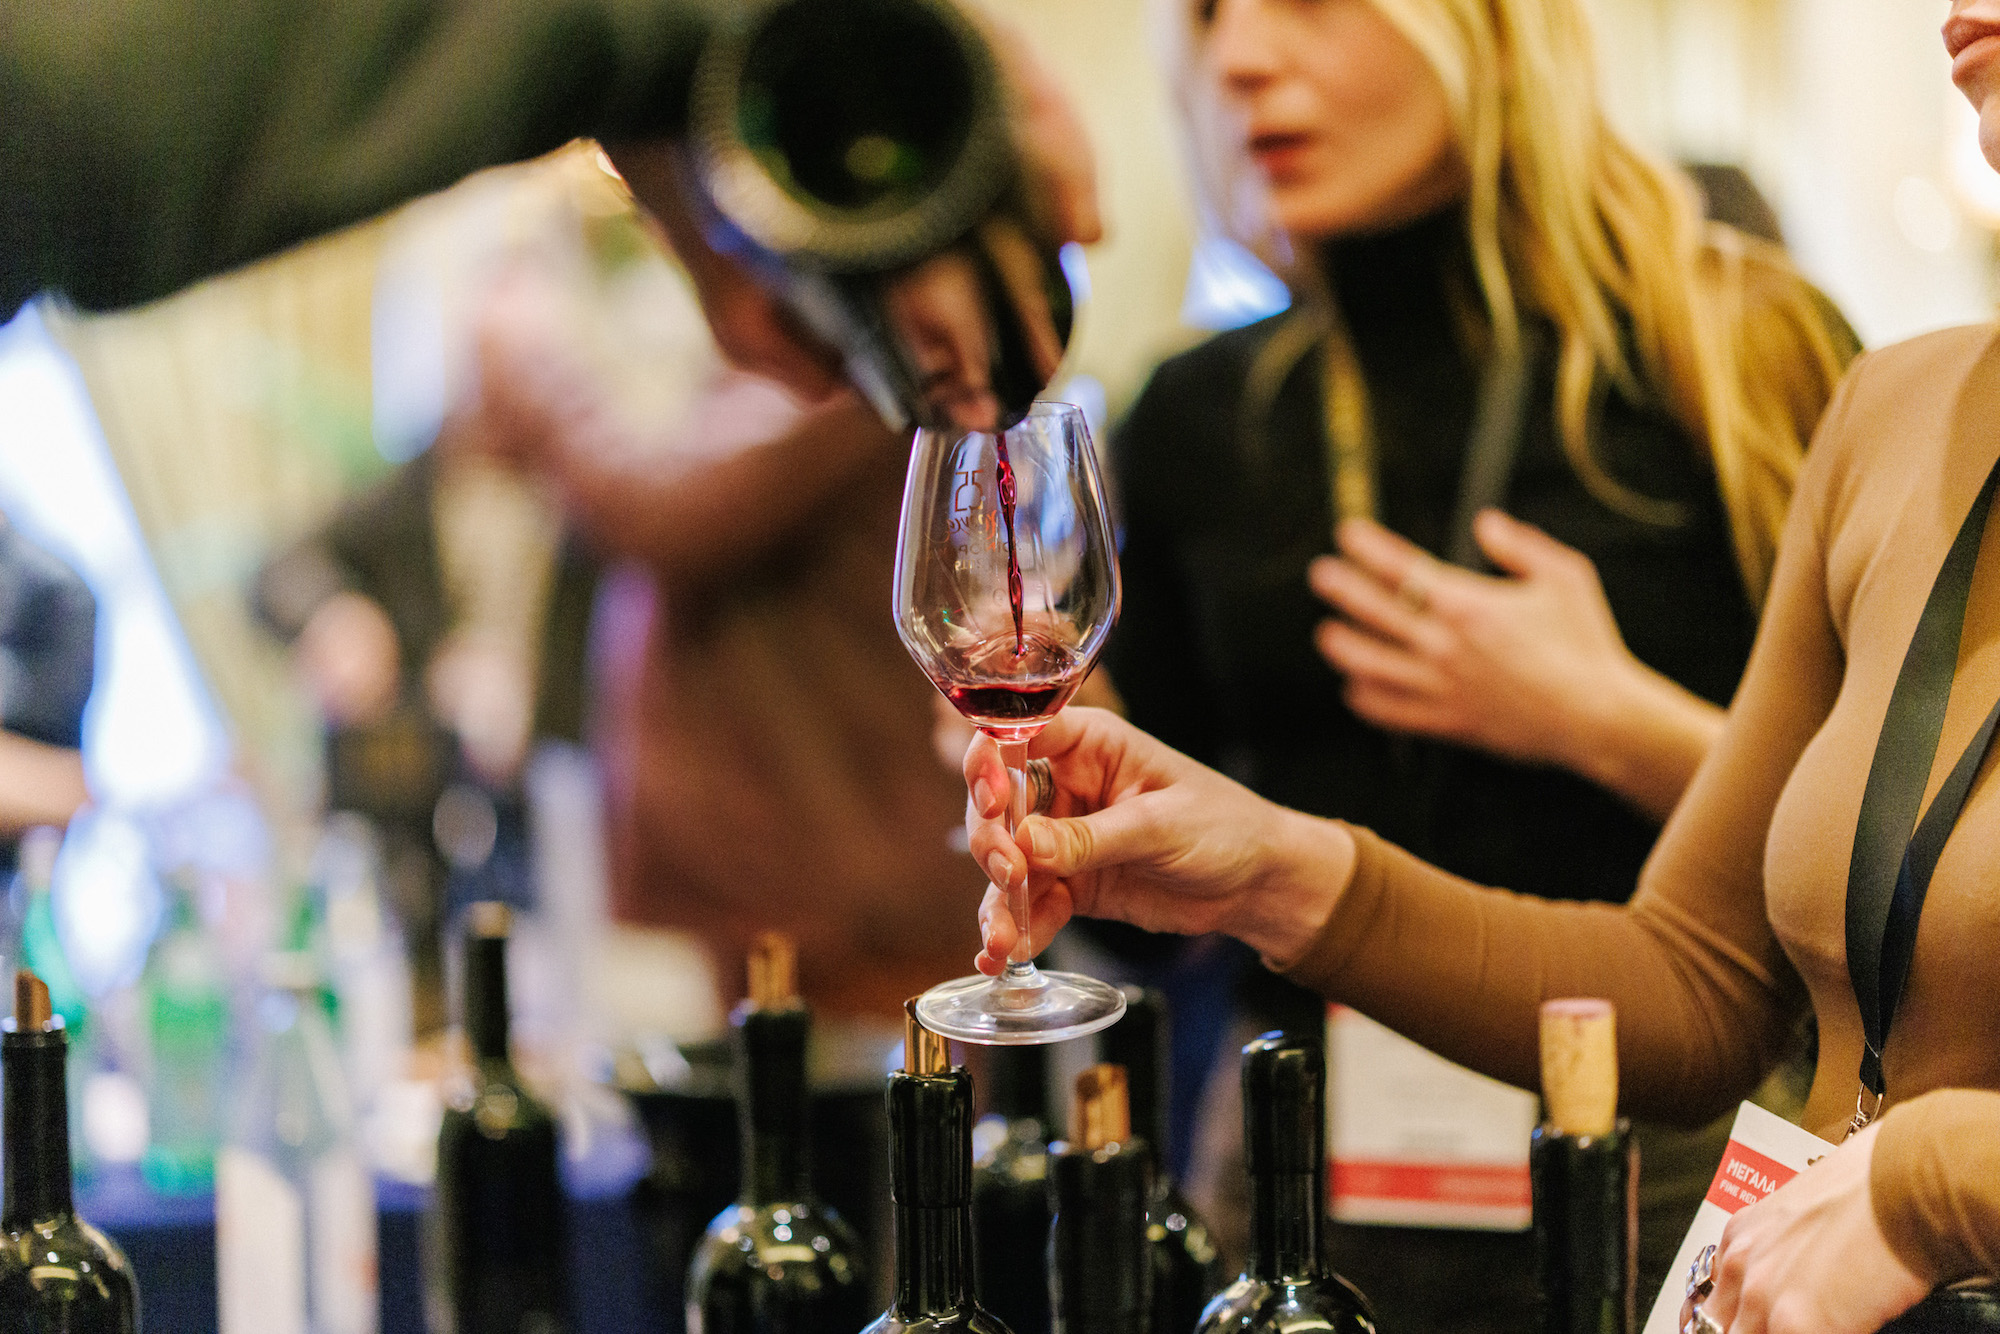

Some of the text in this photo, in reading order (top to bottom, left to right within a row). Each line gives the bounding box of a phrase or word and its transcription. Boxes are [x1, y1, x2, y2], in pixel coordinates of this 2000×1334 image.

[1719, 1178, 1757, 1204] FINE RED
[1726, 1158, 1776, 1194] ΜΕΓΑΛΑ
